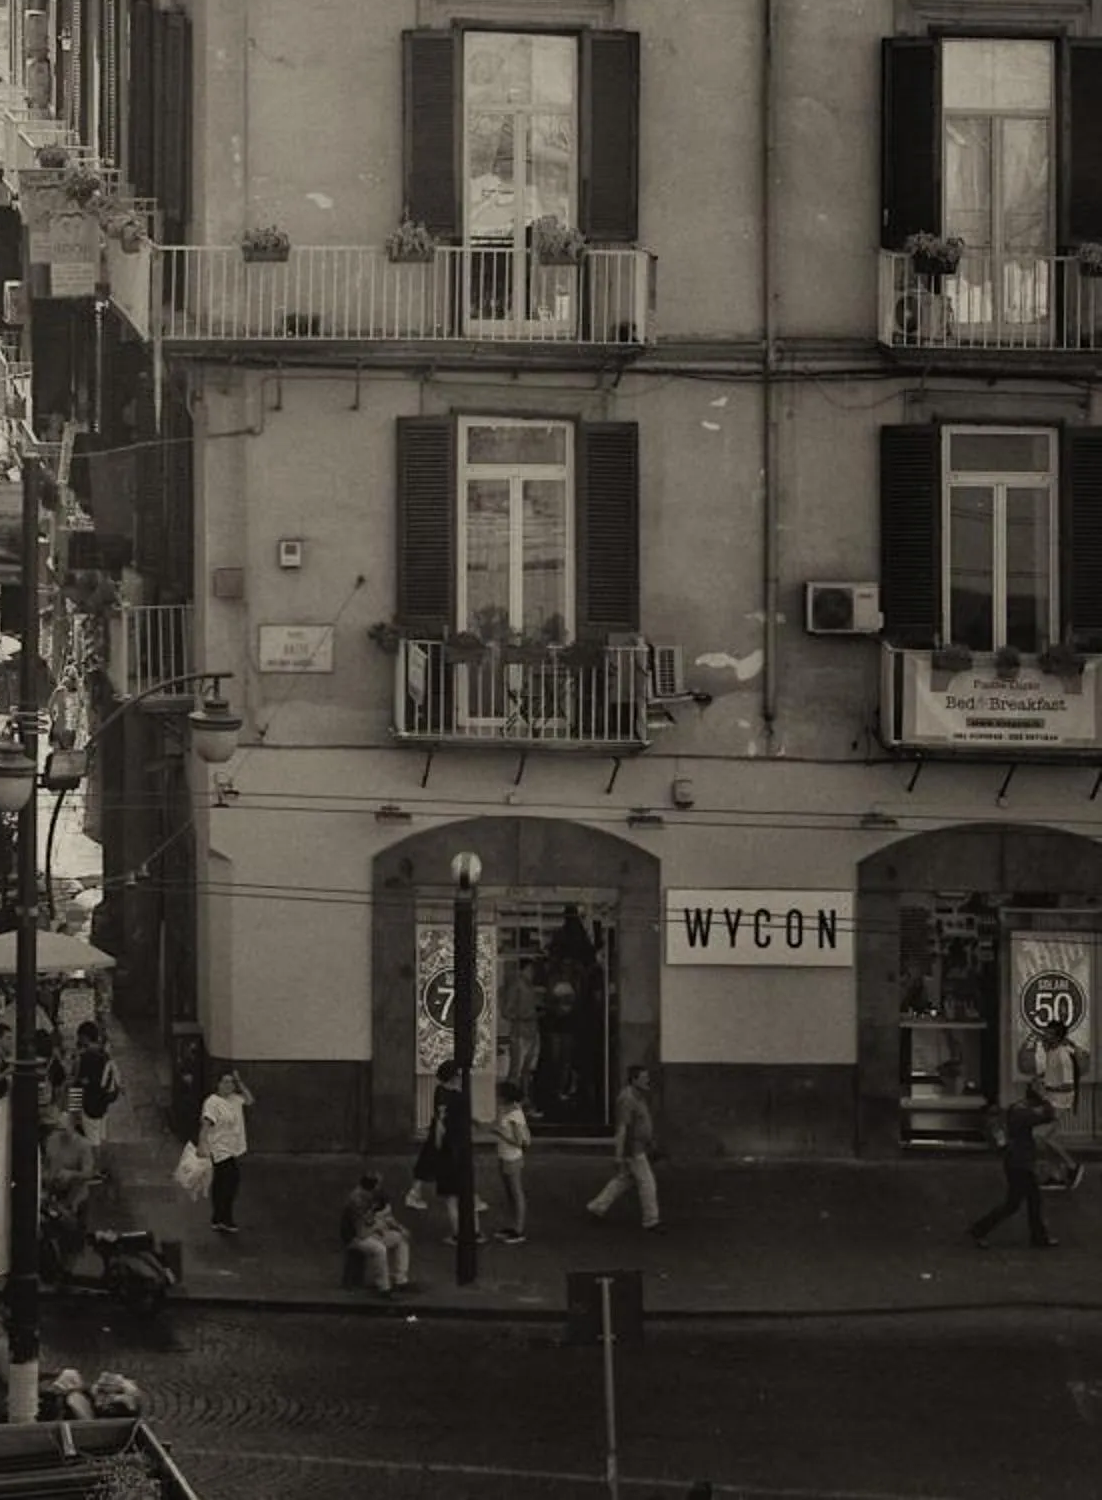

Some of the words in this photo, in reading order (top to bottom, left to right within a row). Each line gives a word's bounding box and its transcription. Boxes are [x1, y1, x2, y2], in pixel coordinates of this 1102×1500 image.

[946, 696, 975, 710] Bed
[988, 696, 1067, 711] Breakfast
[684, 907, 836, 948] WYCON
